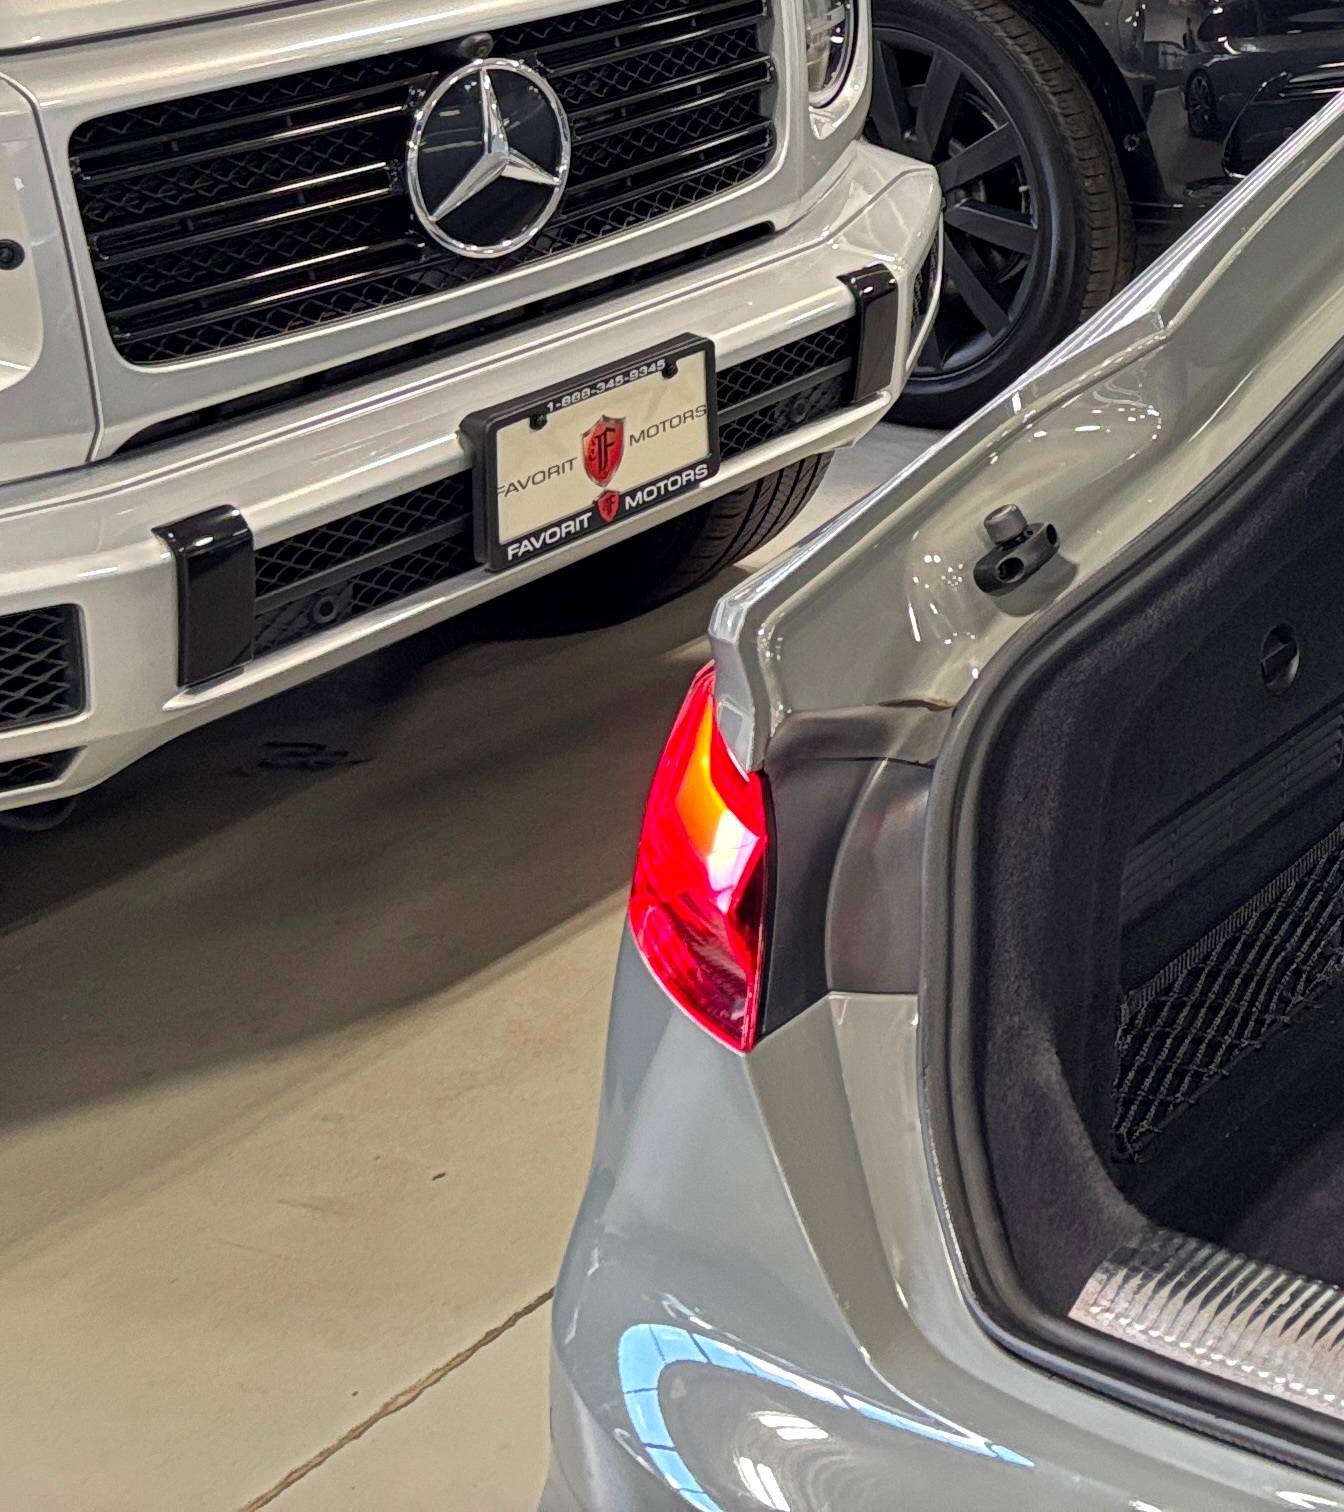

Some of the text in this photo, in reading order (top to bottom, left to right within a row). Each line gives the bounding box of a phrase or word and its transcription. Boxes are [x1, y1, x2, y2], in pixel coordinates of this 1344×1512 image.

[546, 359, 666, 412] 1-888-345-9345
[629, 405, 707, 446] MOTORS
[507, 511, 593, 560] FAVORIT
[624, 463, 709, 510] MOTORS
